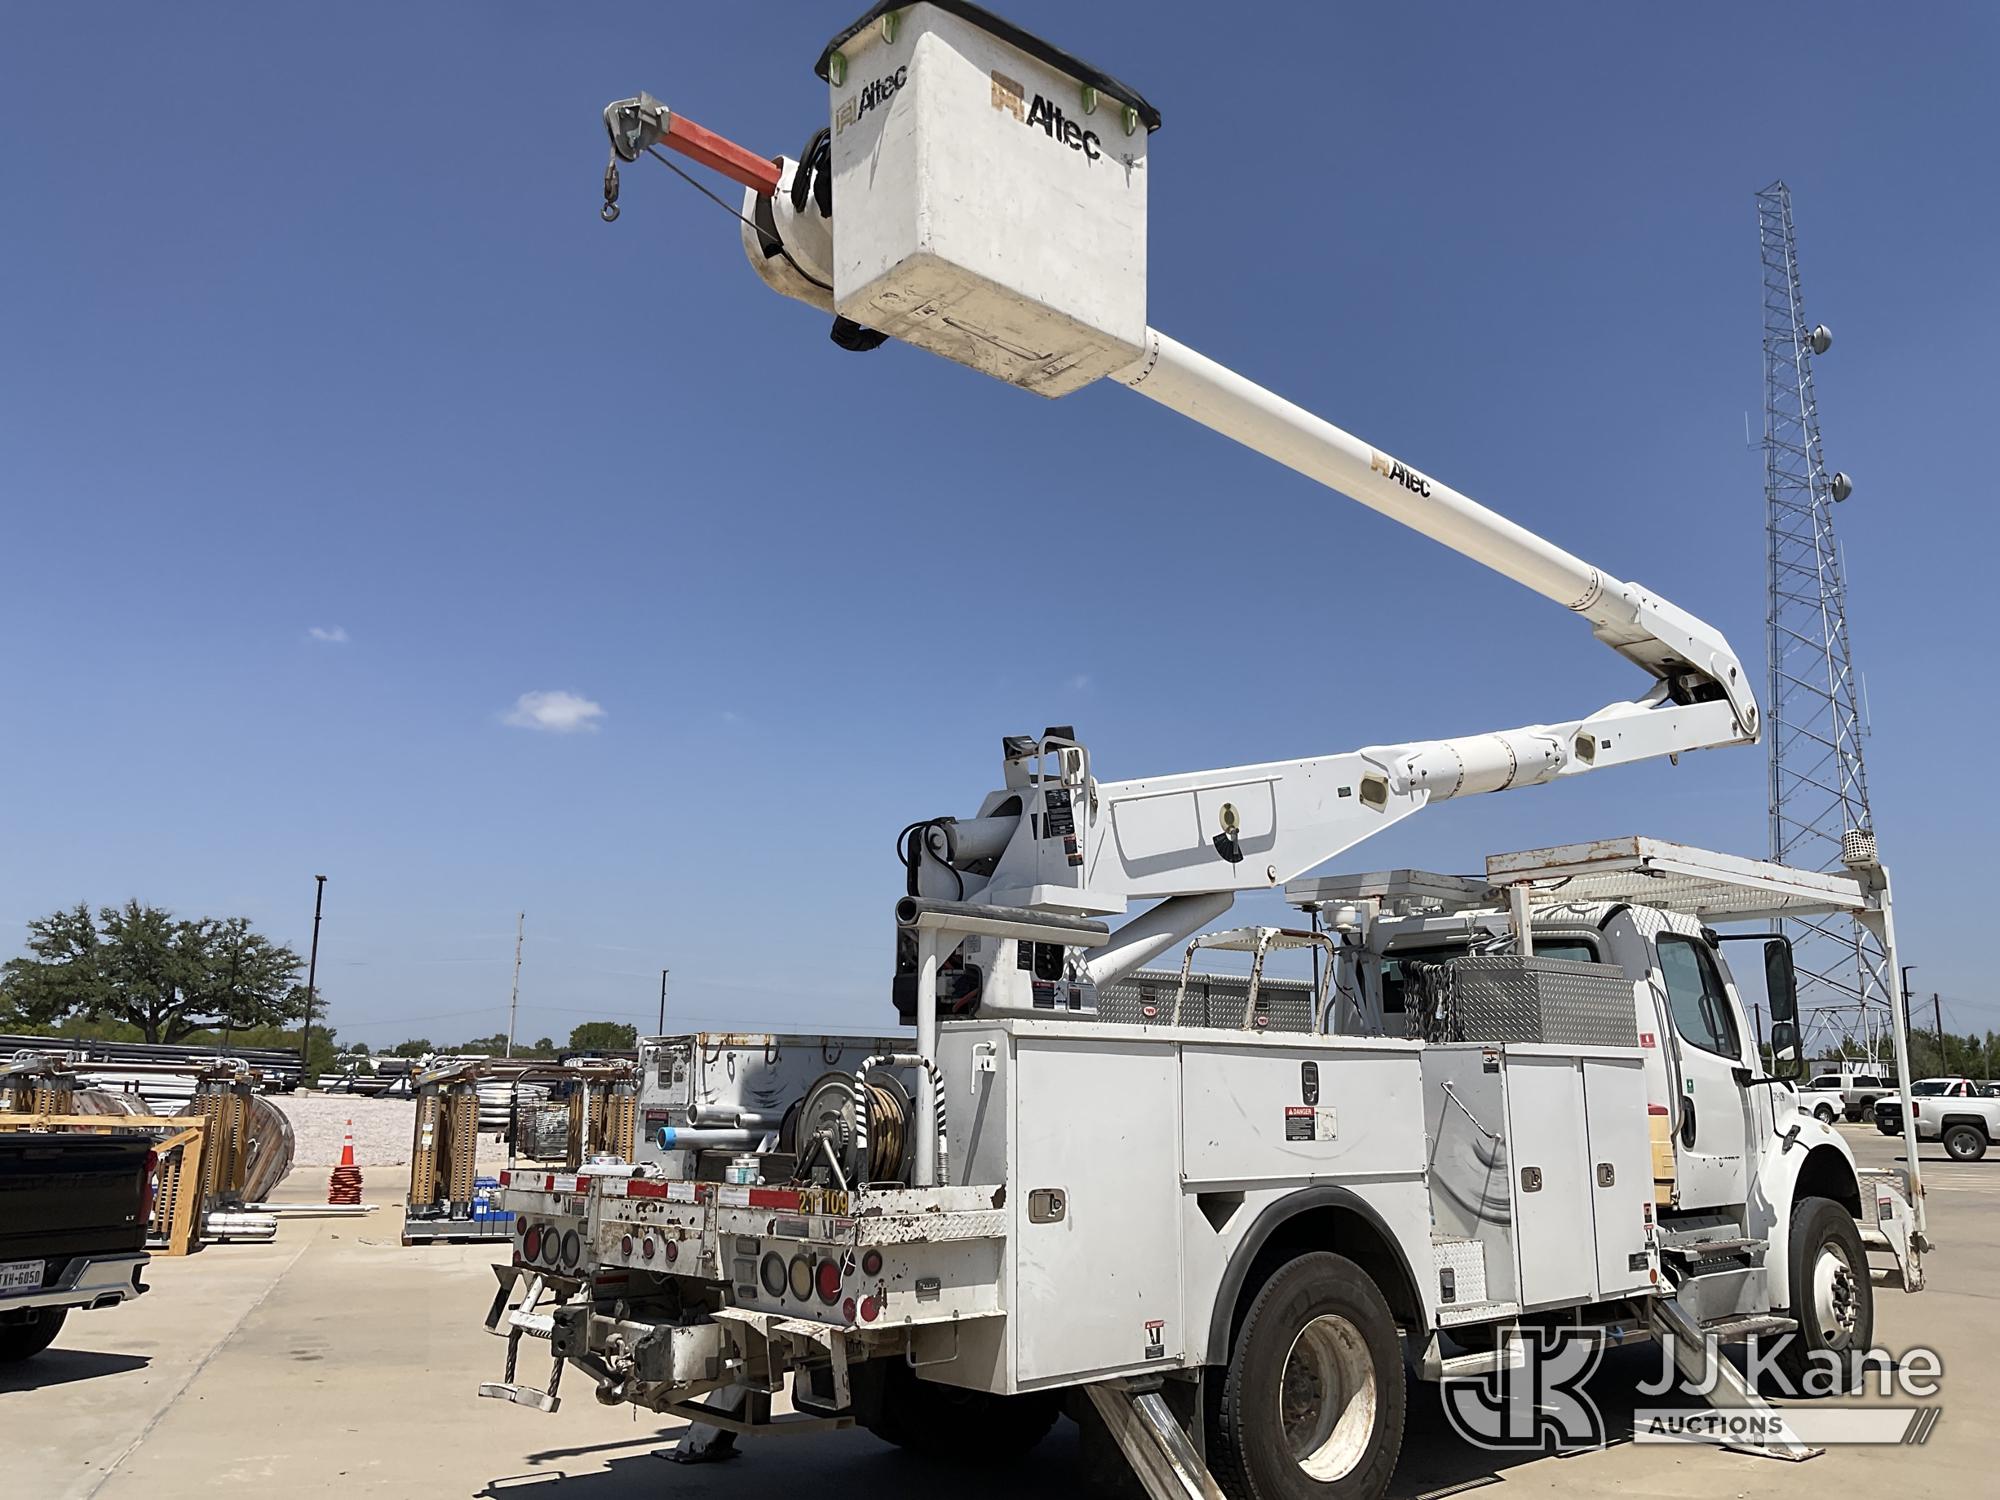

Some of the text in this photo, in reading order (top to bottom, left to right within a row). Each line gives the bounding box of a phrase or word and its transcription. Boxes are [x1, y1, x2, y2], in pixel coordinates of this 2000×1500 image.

[857, 65, 907, 120] Altec
[1026, 95, 1101, 160] Altec
[1389, 461, 1430, 498] Altec
